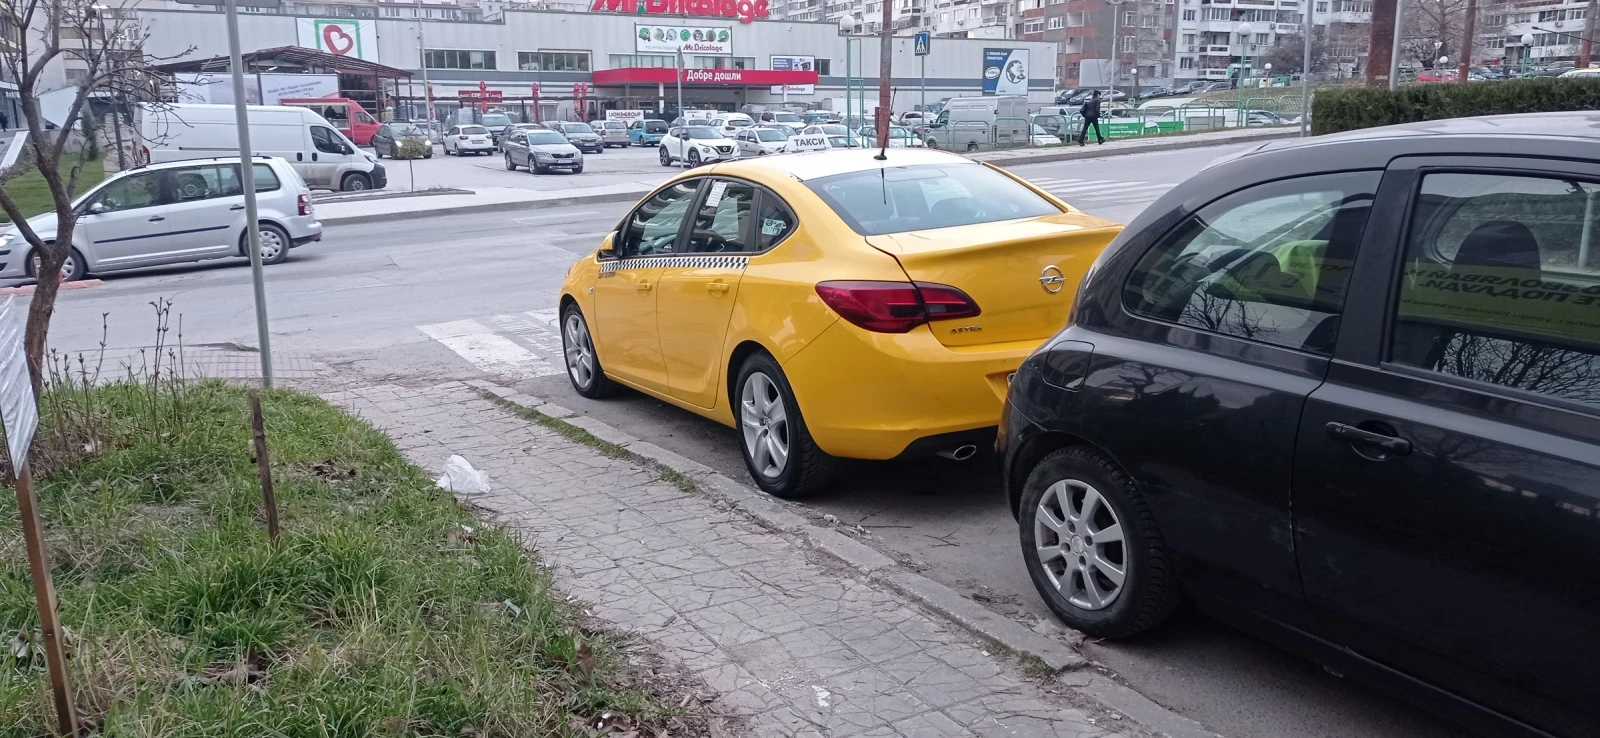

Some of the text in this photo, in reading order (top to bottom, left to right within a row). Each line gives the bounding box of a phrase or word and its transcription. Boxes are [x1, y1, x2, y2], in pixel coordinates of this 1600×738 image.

[683, 43, 723, 52] Mr.Bricolage
[686, 69, 742, 82] Добре дошли
[794, 137, 825, 147] ТАКСИ
[951, 326, 982, 334] ASTRA
